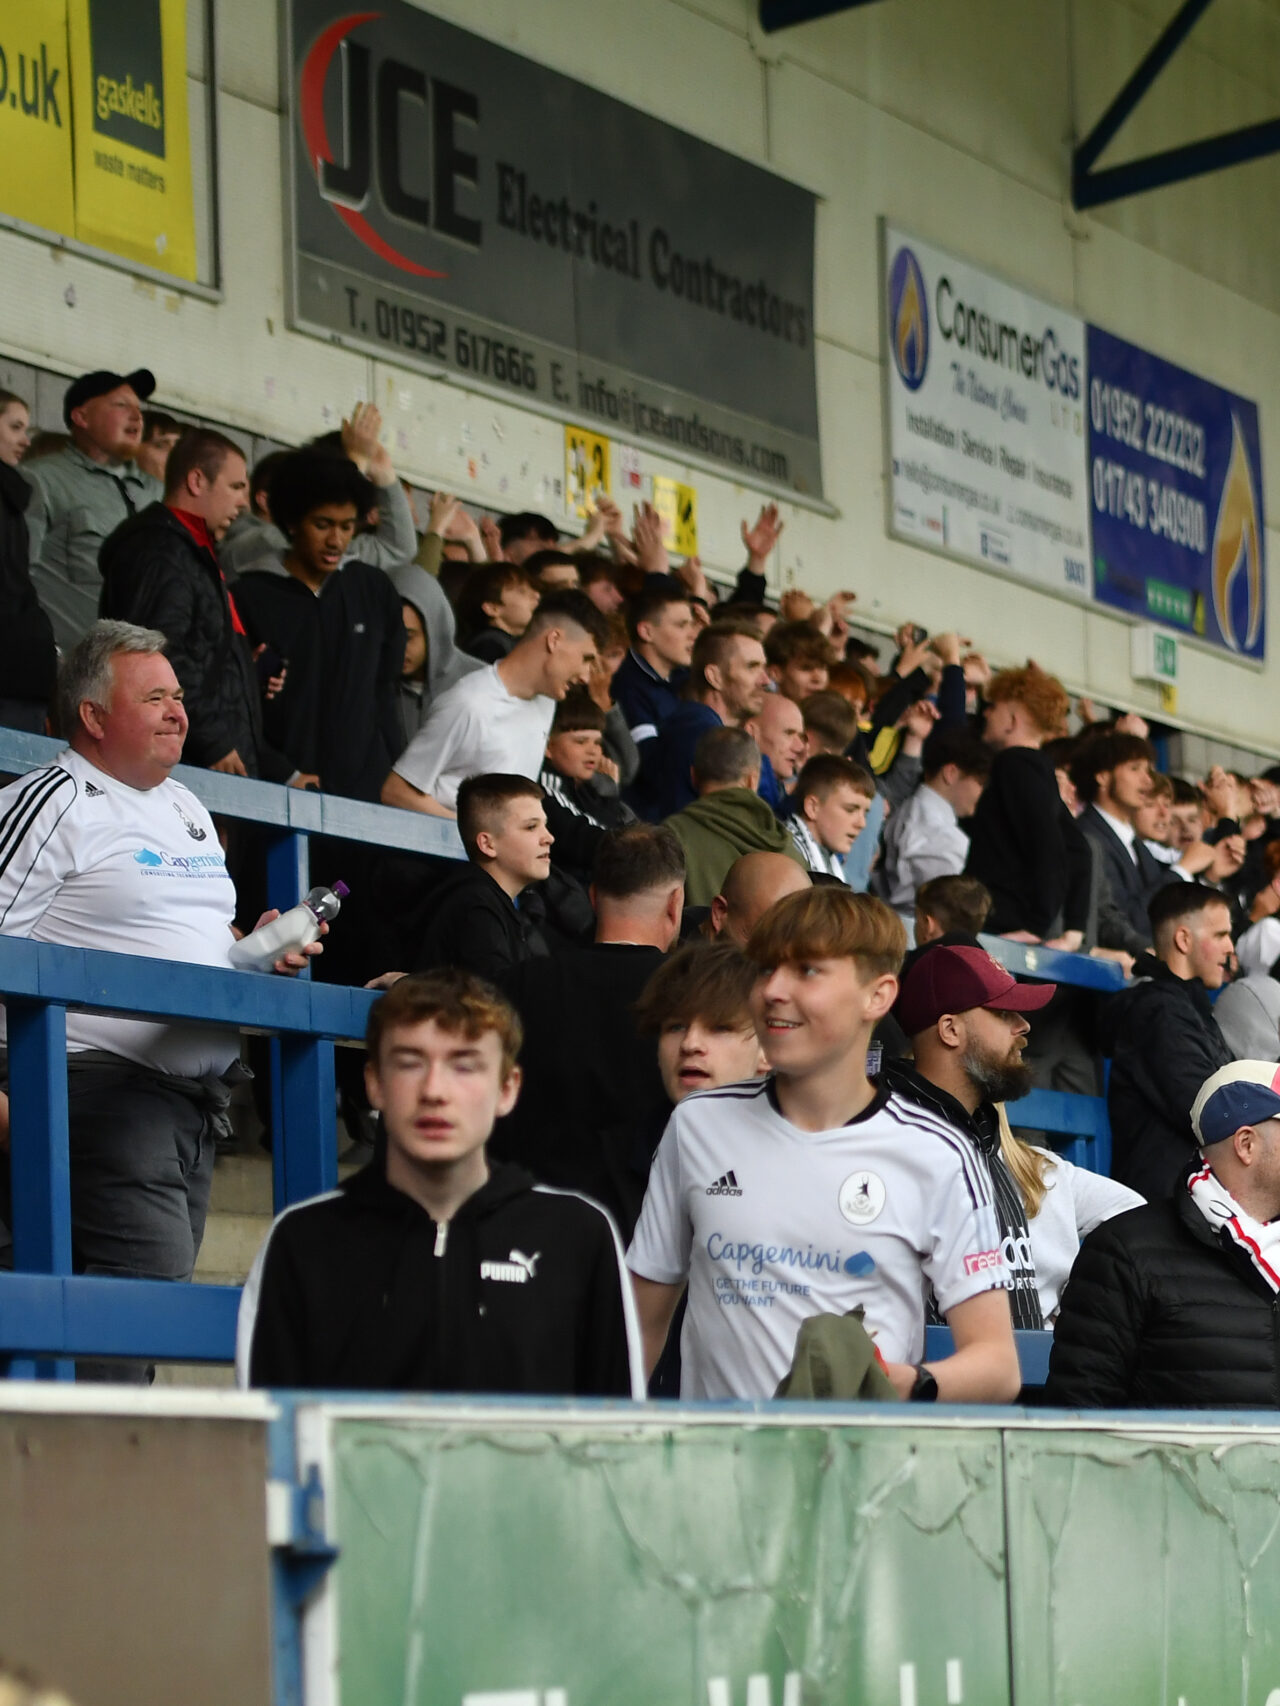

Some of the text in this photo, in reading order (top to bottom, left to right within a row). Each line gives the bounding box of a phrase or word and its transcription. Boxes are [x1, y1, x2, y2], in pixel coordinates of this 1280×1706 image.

[97, 73, 161, 129] gaskells
[318, 38, 482, 251] JCE
[94, 149, 166, 194] waste matters
[495, 161, 807, 348] Electrical Contractors
[375, 301, 447, 359] 01952
[455, 329, 536, 391] 617666
[936, 277, 1079, 401] ConsumerGas
[706, 1185, 742, 1197] adidas
[480, 1262, 526, 1283] PUMA
[707, 1232, 841, 1275] Capgemini
[761, 1280, 810, 1297] FUTURE
